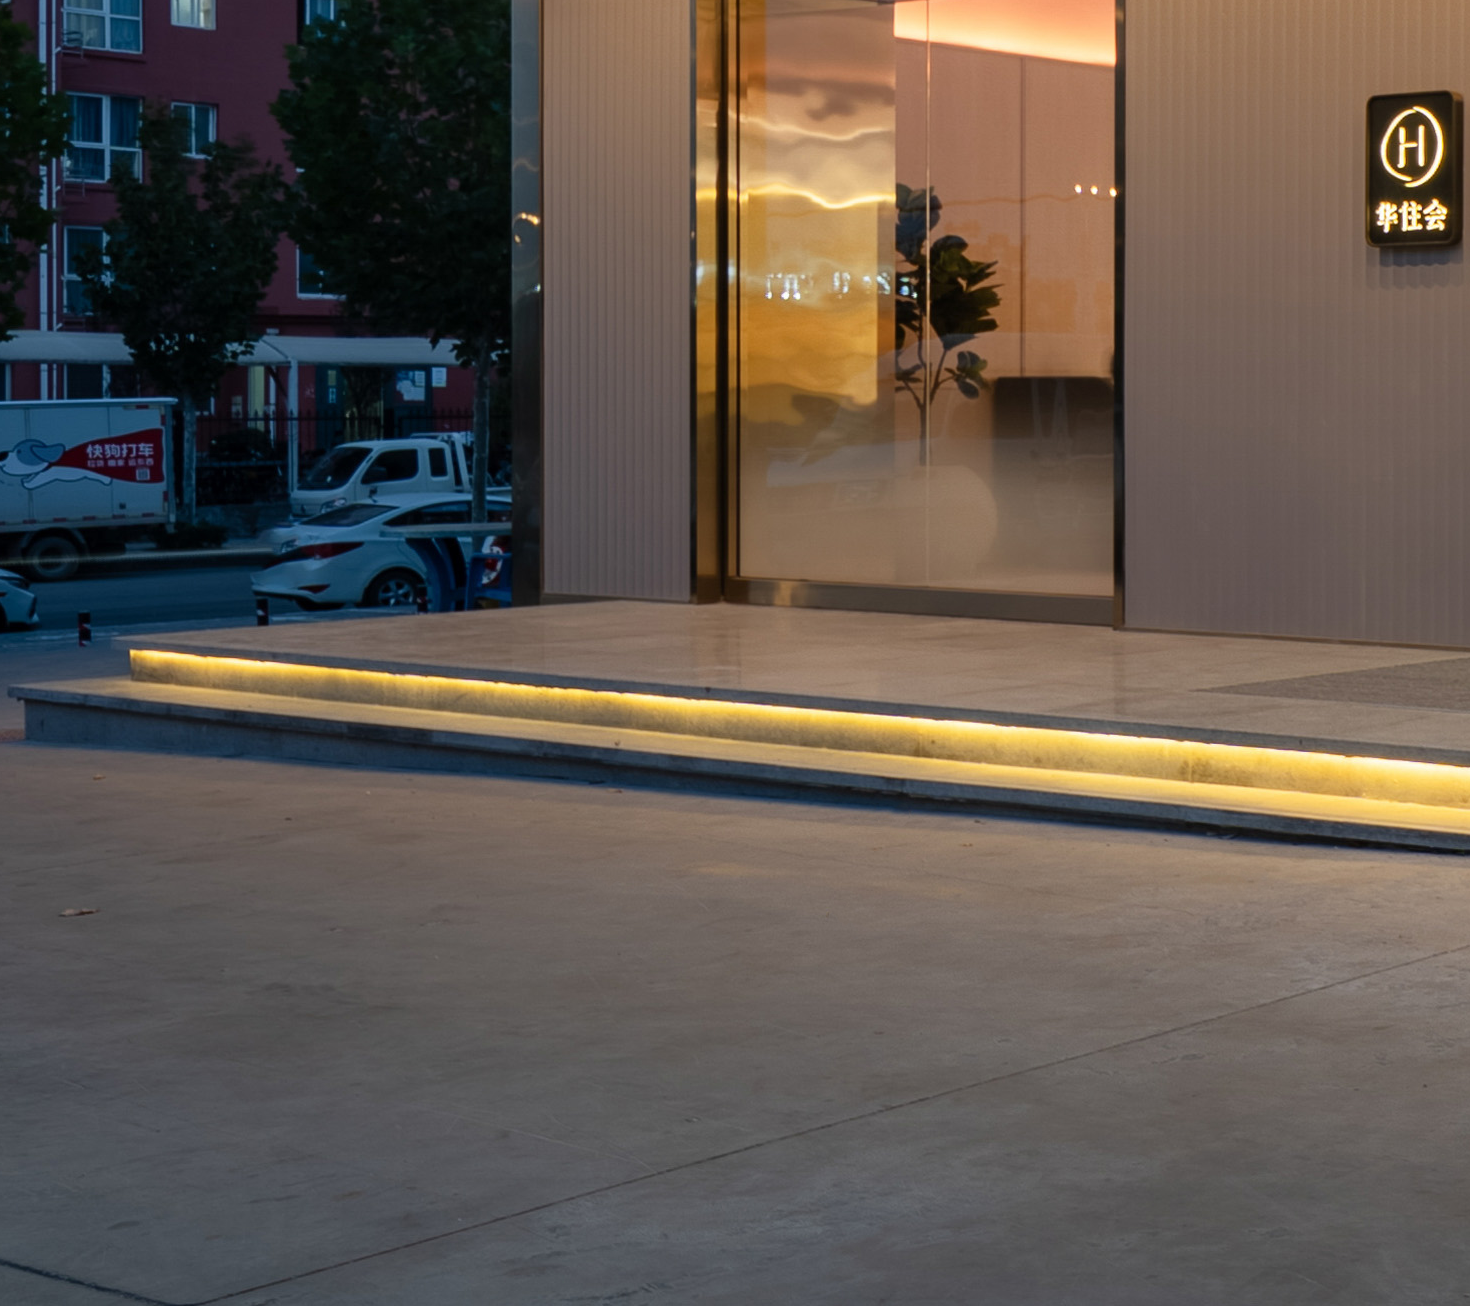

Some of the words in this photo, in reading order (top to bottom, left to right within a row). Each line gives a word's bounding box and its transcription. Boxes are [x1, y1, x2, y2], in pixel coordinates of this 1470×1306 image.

[1375, 198, 1448, 233] 华住会
[86, 443, 154, 459] 快狗打车
